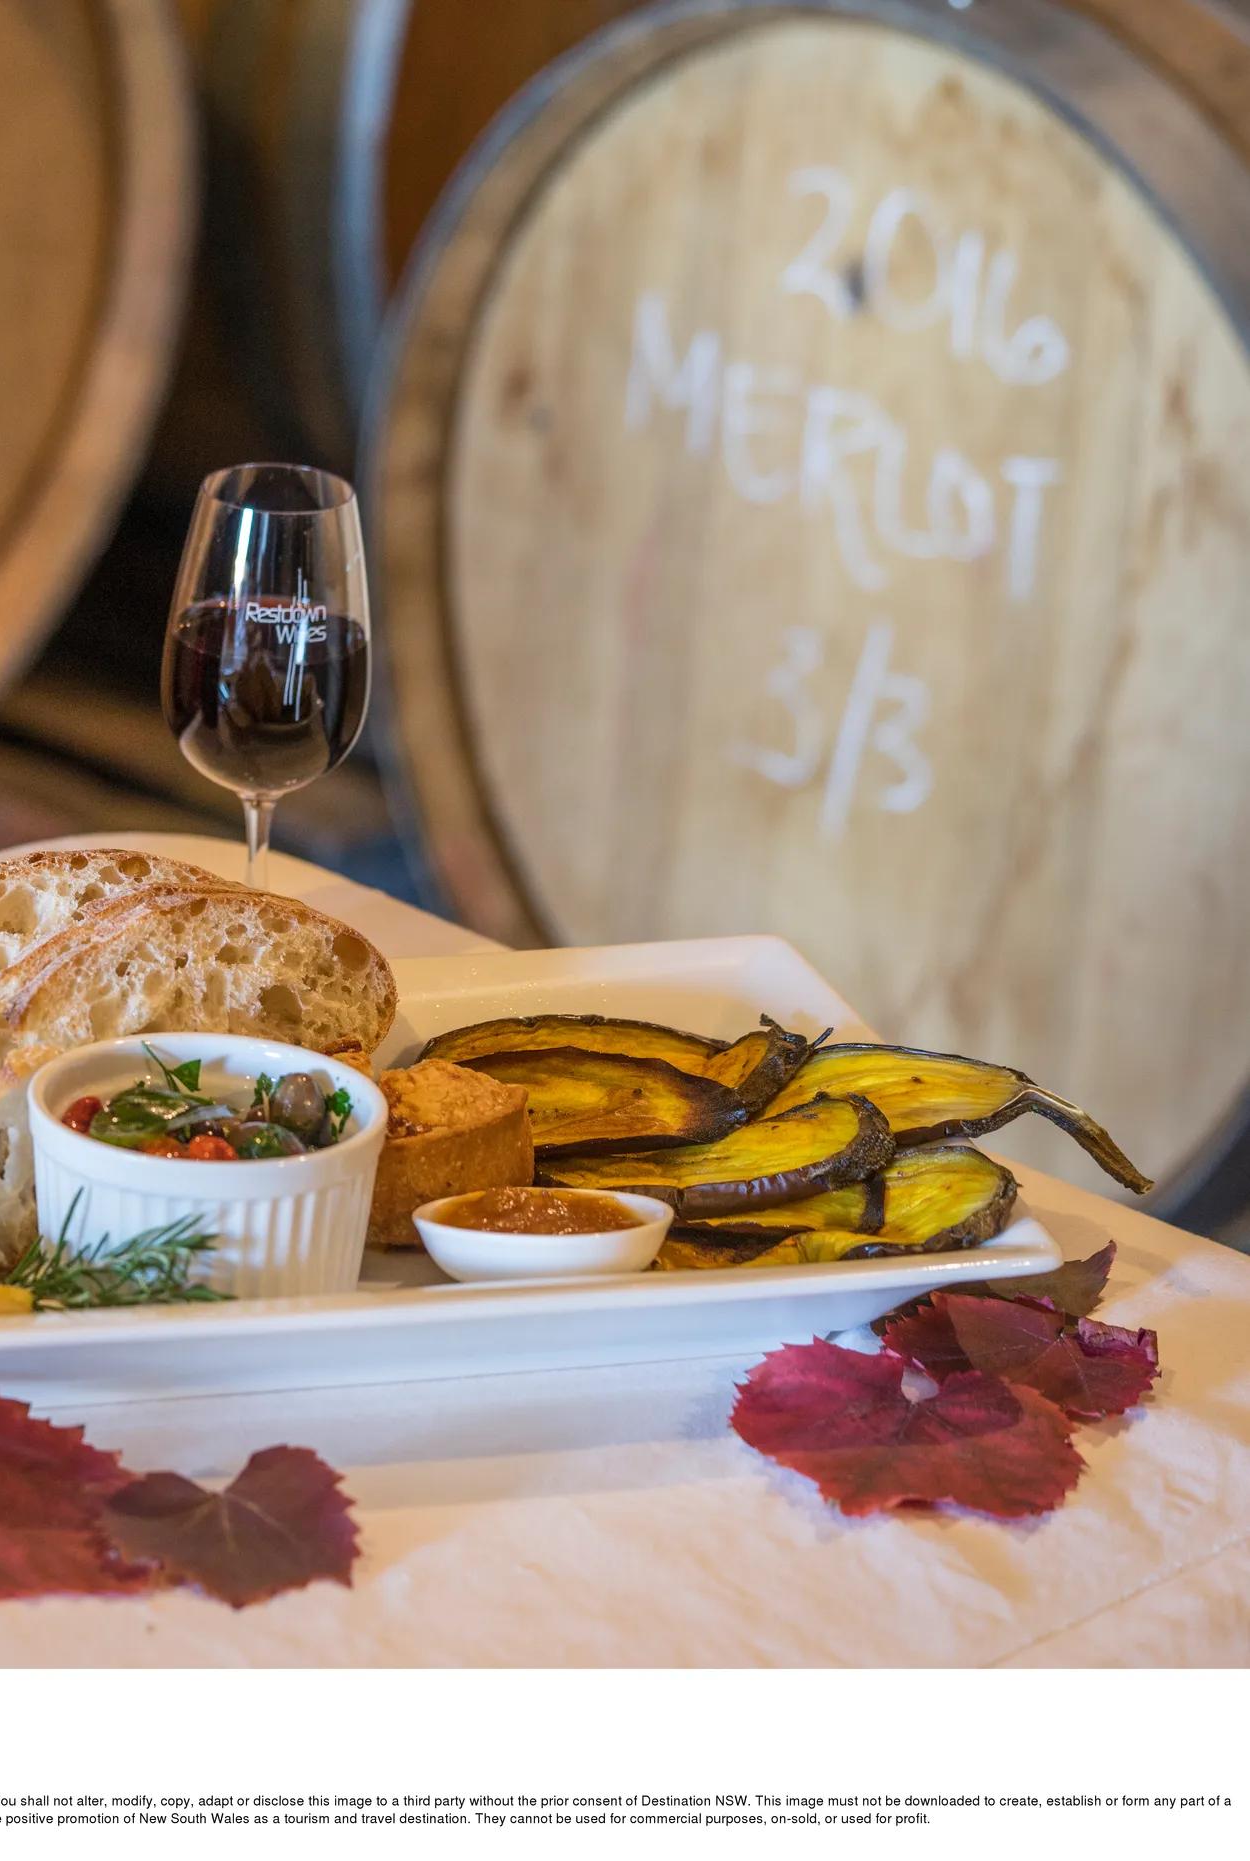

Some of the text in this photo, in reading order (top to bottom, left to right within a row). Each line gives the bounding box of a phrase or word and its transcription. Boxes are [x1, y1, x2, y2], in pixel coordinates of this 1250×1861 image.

[780, 165, 1070, 387] 2016
[624, 288, 1062, 602] MERLOT
[245, 602, 327, 624] Restdown
[275, 623, 328, 645] Wes
[727, 615, 932, 842] 3/3
